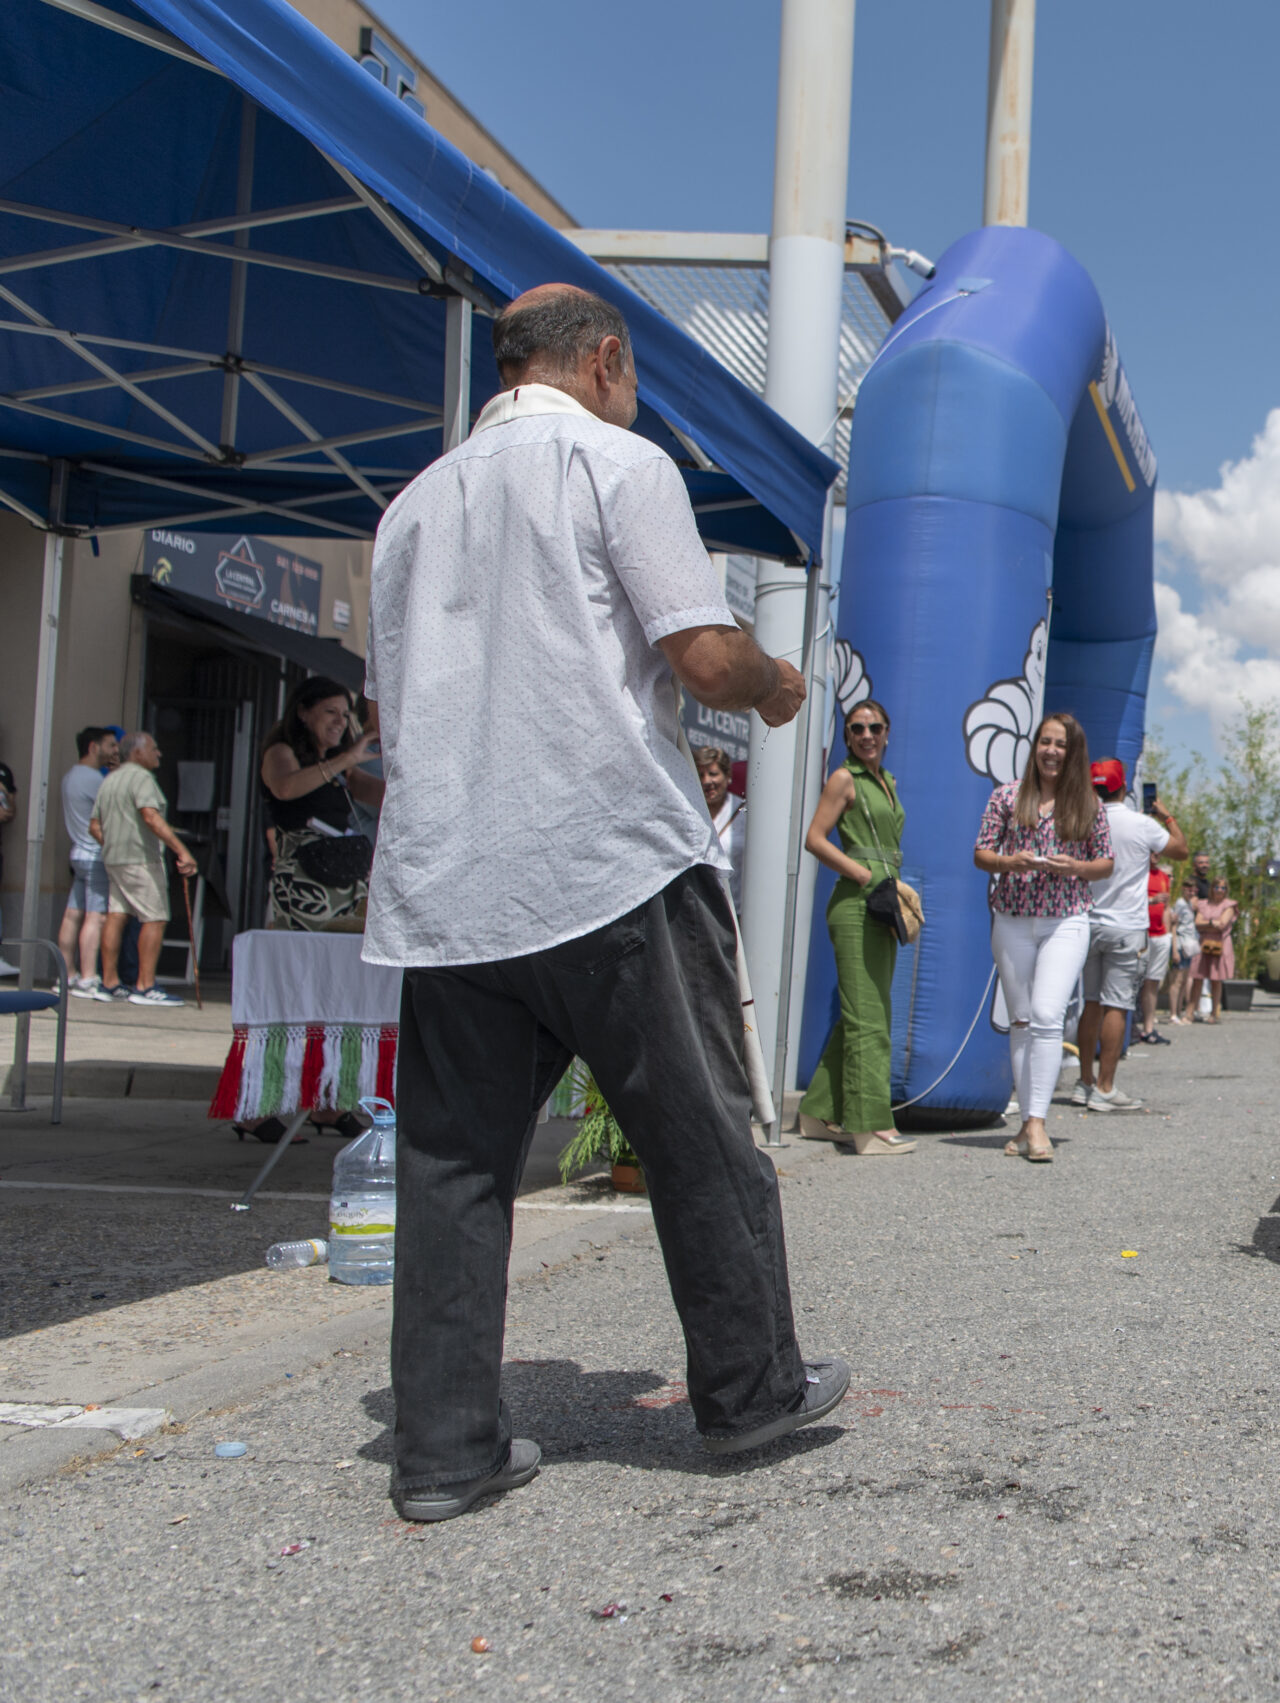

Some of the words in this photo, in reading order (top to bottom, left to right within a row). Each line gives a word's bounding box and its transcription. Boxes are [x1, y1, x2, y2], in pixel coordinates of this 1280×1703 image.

[152, 529, 195, 554] DIARIO
[697, 703, 713, 729] LA
[714, 710, 750, 742] CENTR
